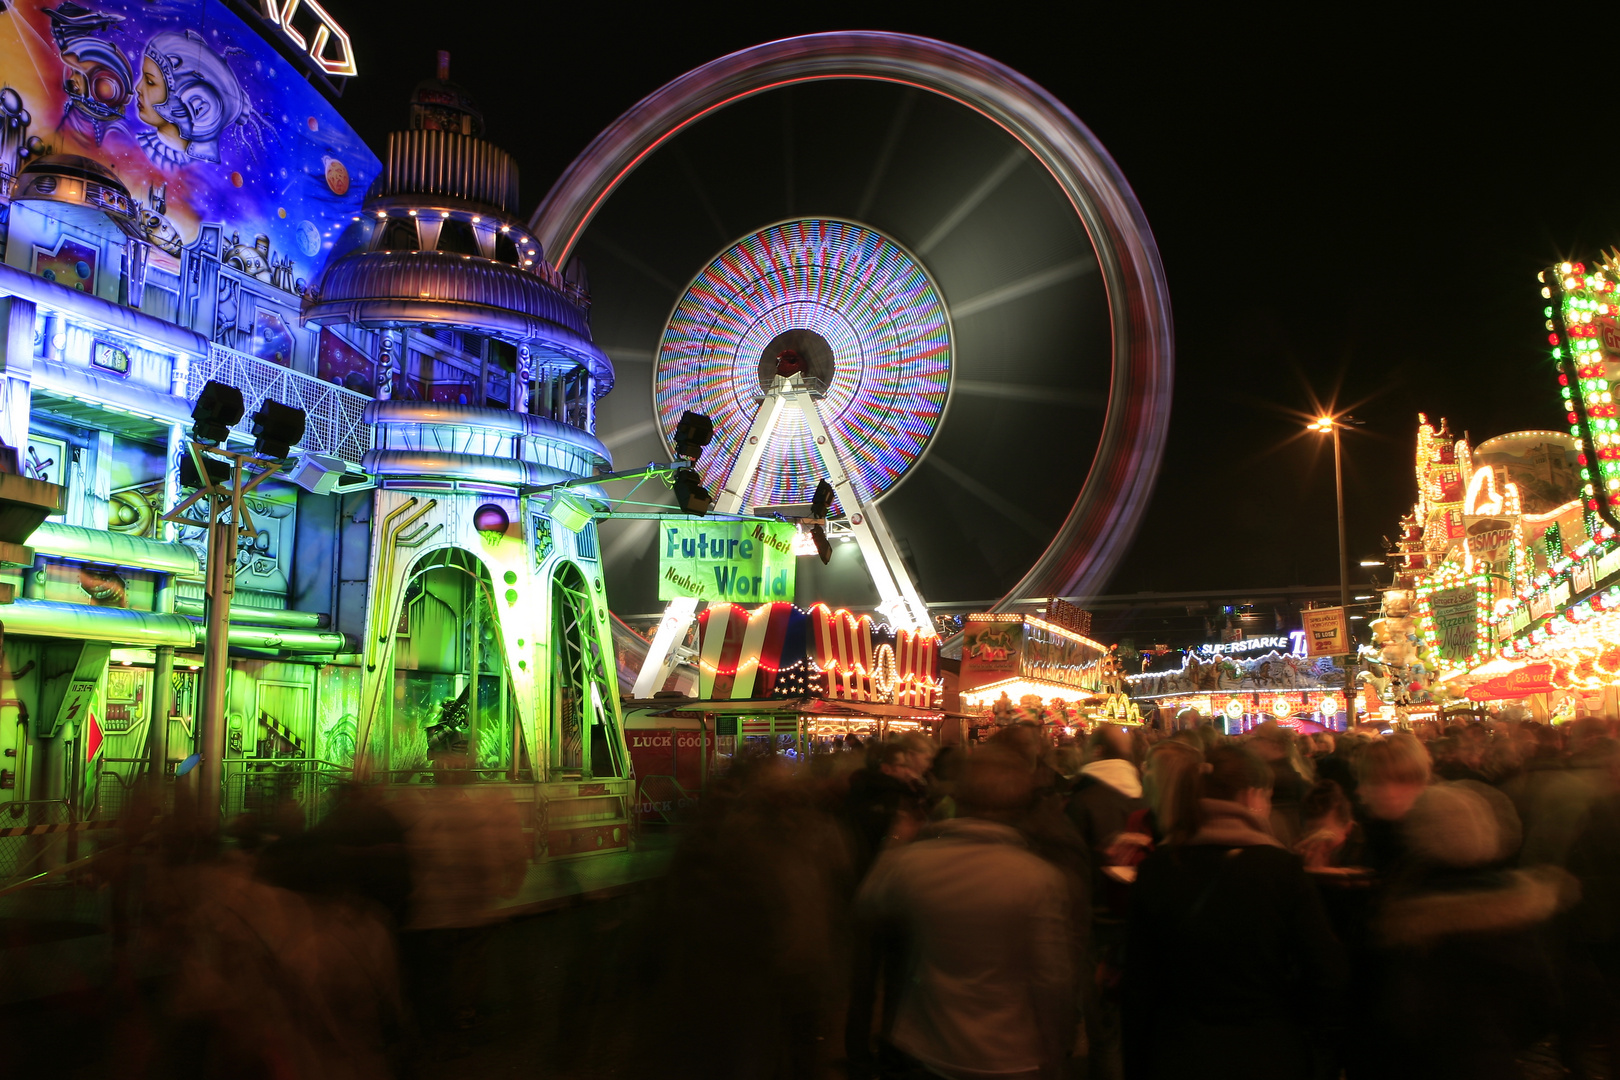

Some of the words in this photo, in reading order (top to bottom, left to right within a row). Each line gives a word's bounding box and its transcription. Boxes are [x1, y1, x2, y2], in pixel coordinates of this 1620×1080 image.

[666, 528, 754, 559] Future
[751, 524, 792, 555] Neuheit
[665, 566, 706, 595] Neuheit
[714, 566, 788, 597] World
[1201, 637, 1289, 655] SUPERSTARKE
[1515, 673, 1530, 683] Eis
[633, 736, 672, 747] LUCK
[677, 737, 711, 747] GOOD
[635, 801, 672, 813] LUCK
